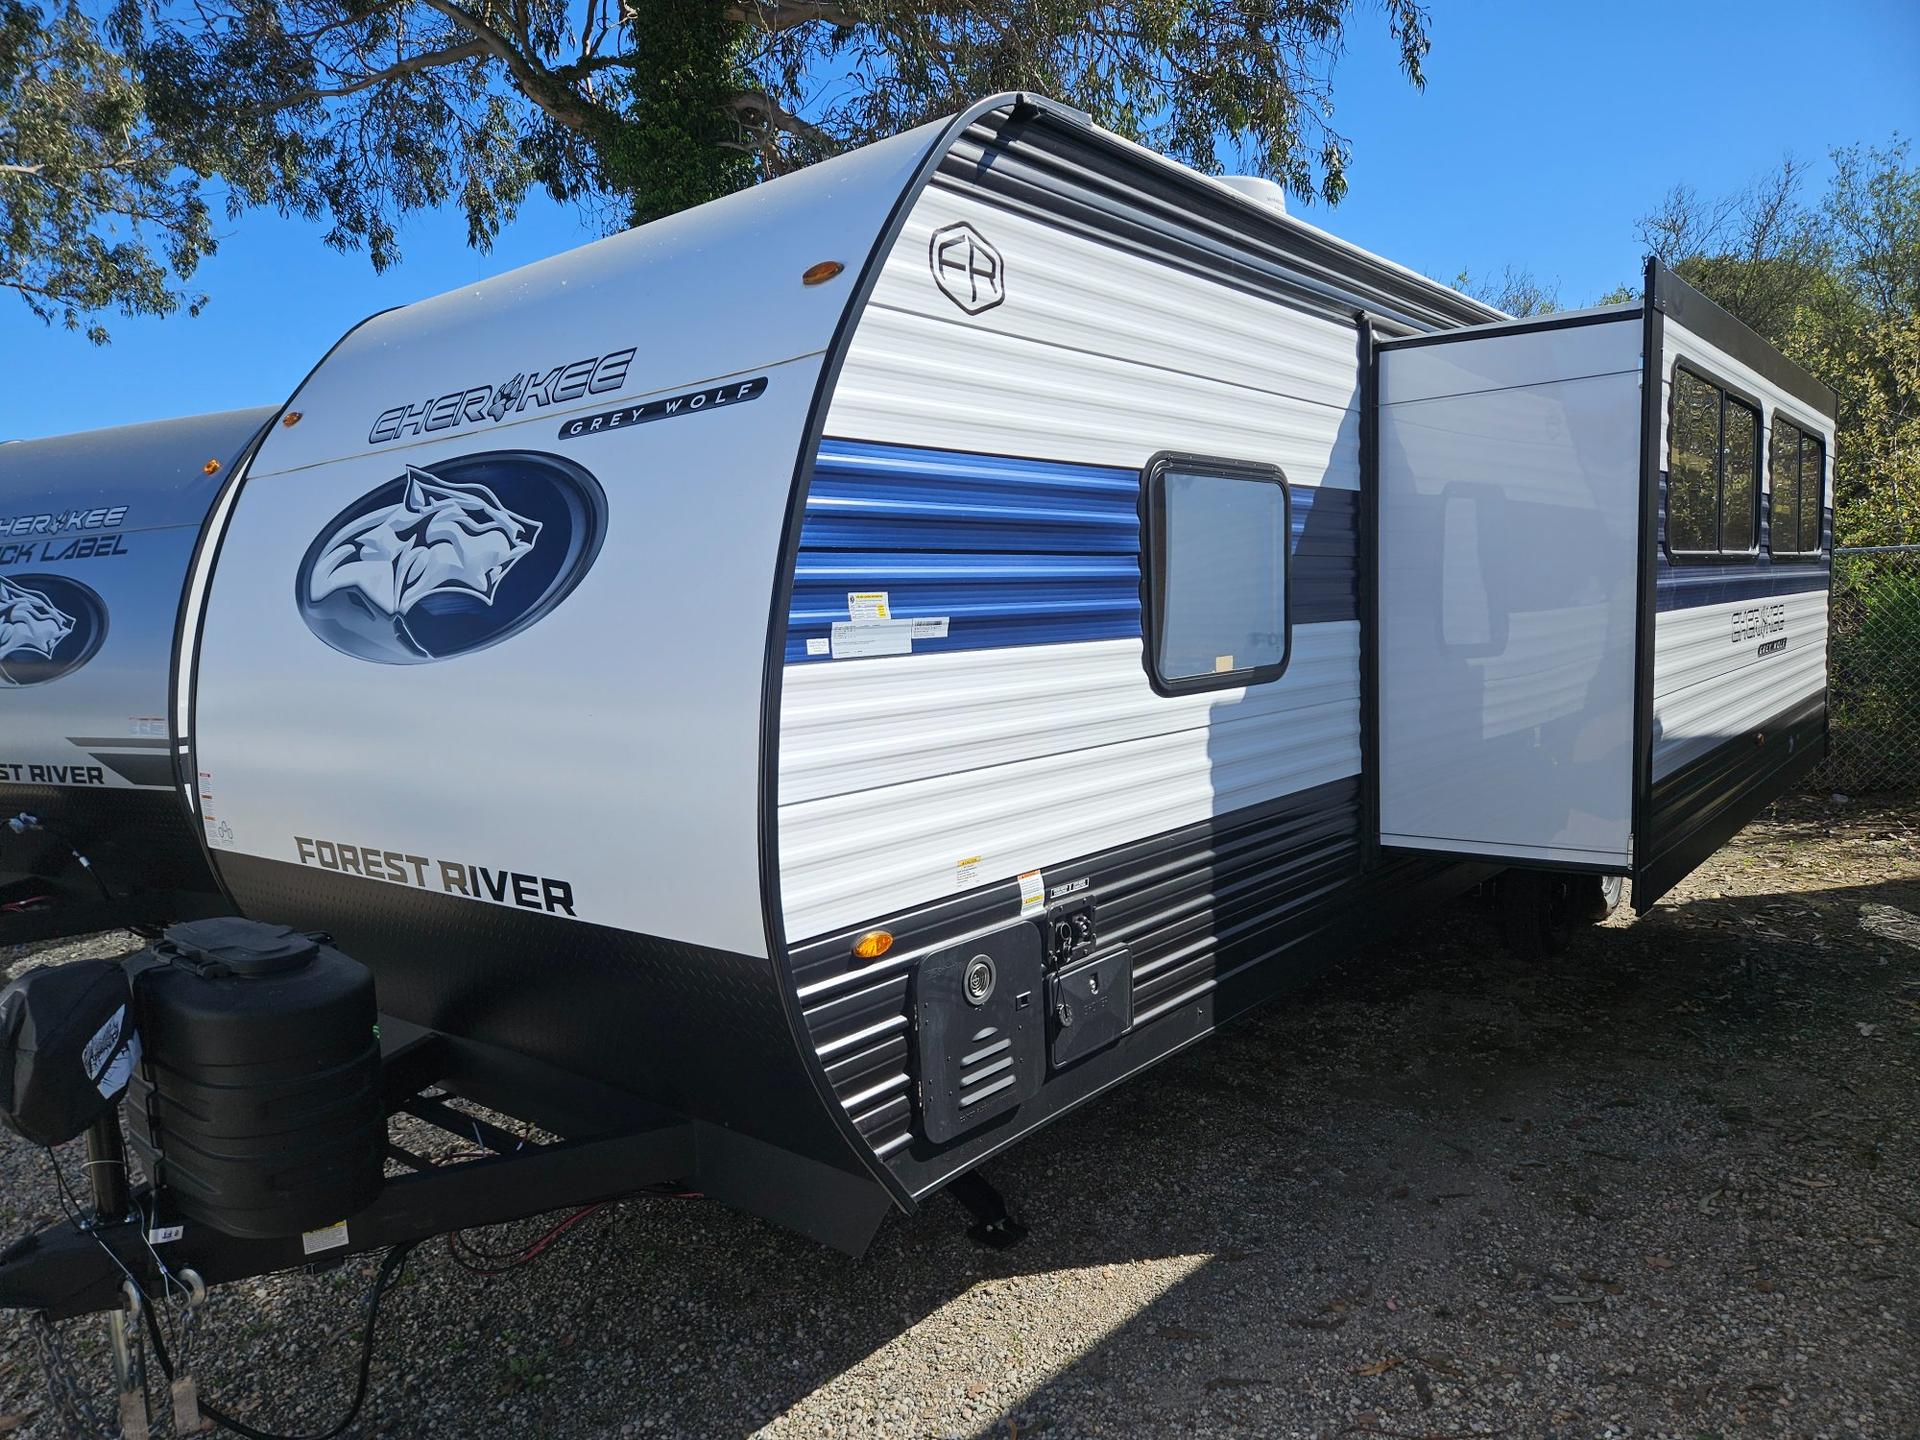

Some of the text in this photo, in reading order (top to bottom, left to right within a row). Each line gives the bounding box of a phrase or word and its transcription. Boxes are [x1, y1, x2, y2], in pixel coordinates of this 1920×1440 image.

[570, 383, 753, 435] GREY WOLF
[0, 505, 130, 537] HEROKEE
[0, 534, 128, 566] CK LABEL
[0, 763, 105, 785] ST RIVER
[294, 836, 578, 918] FOREST RIVER
